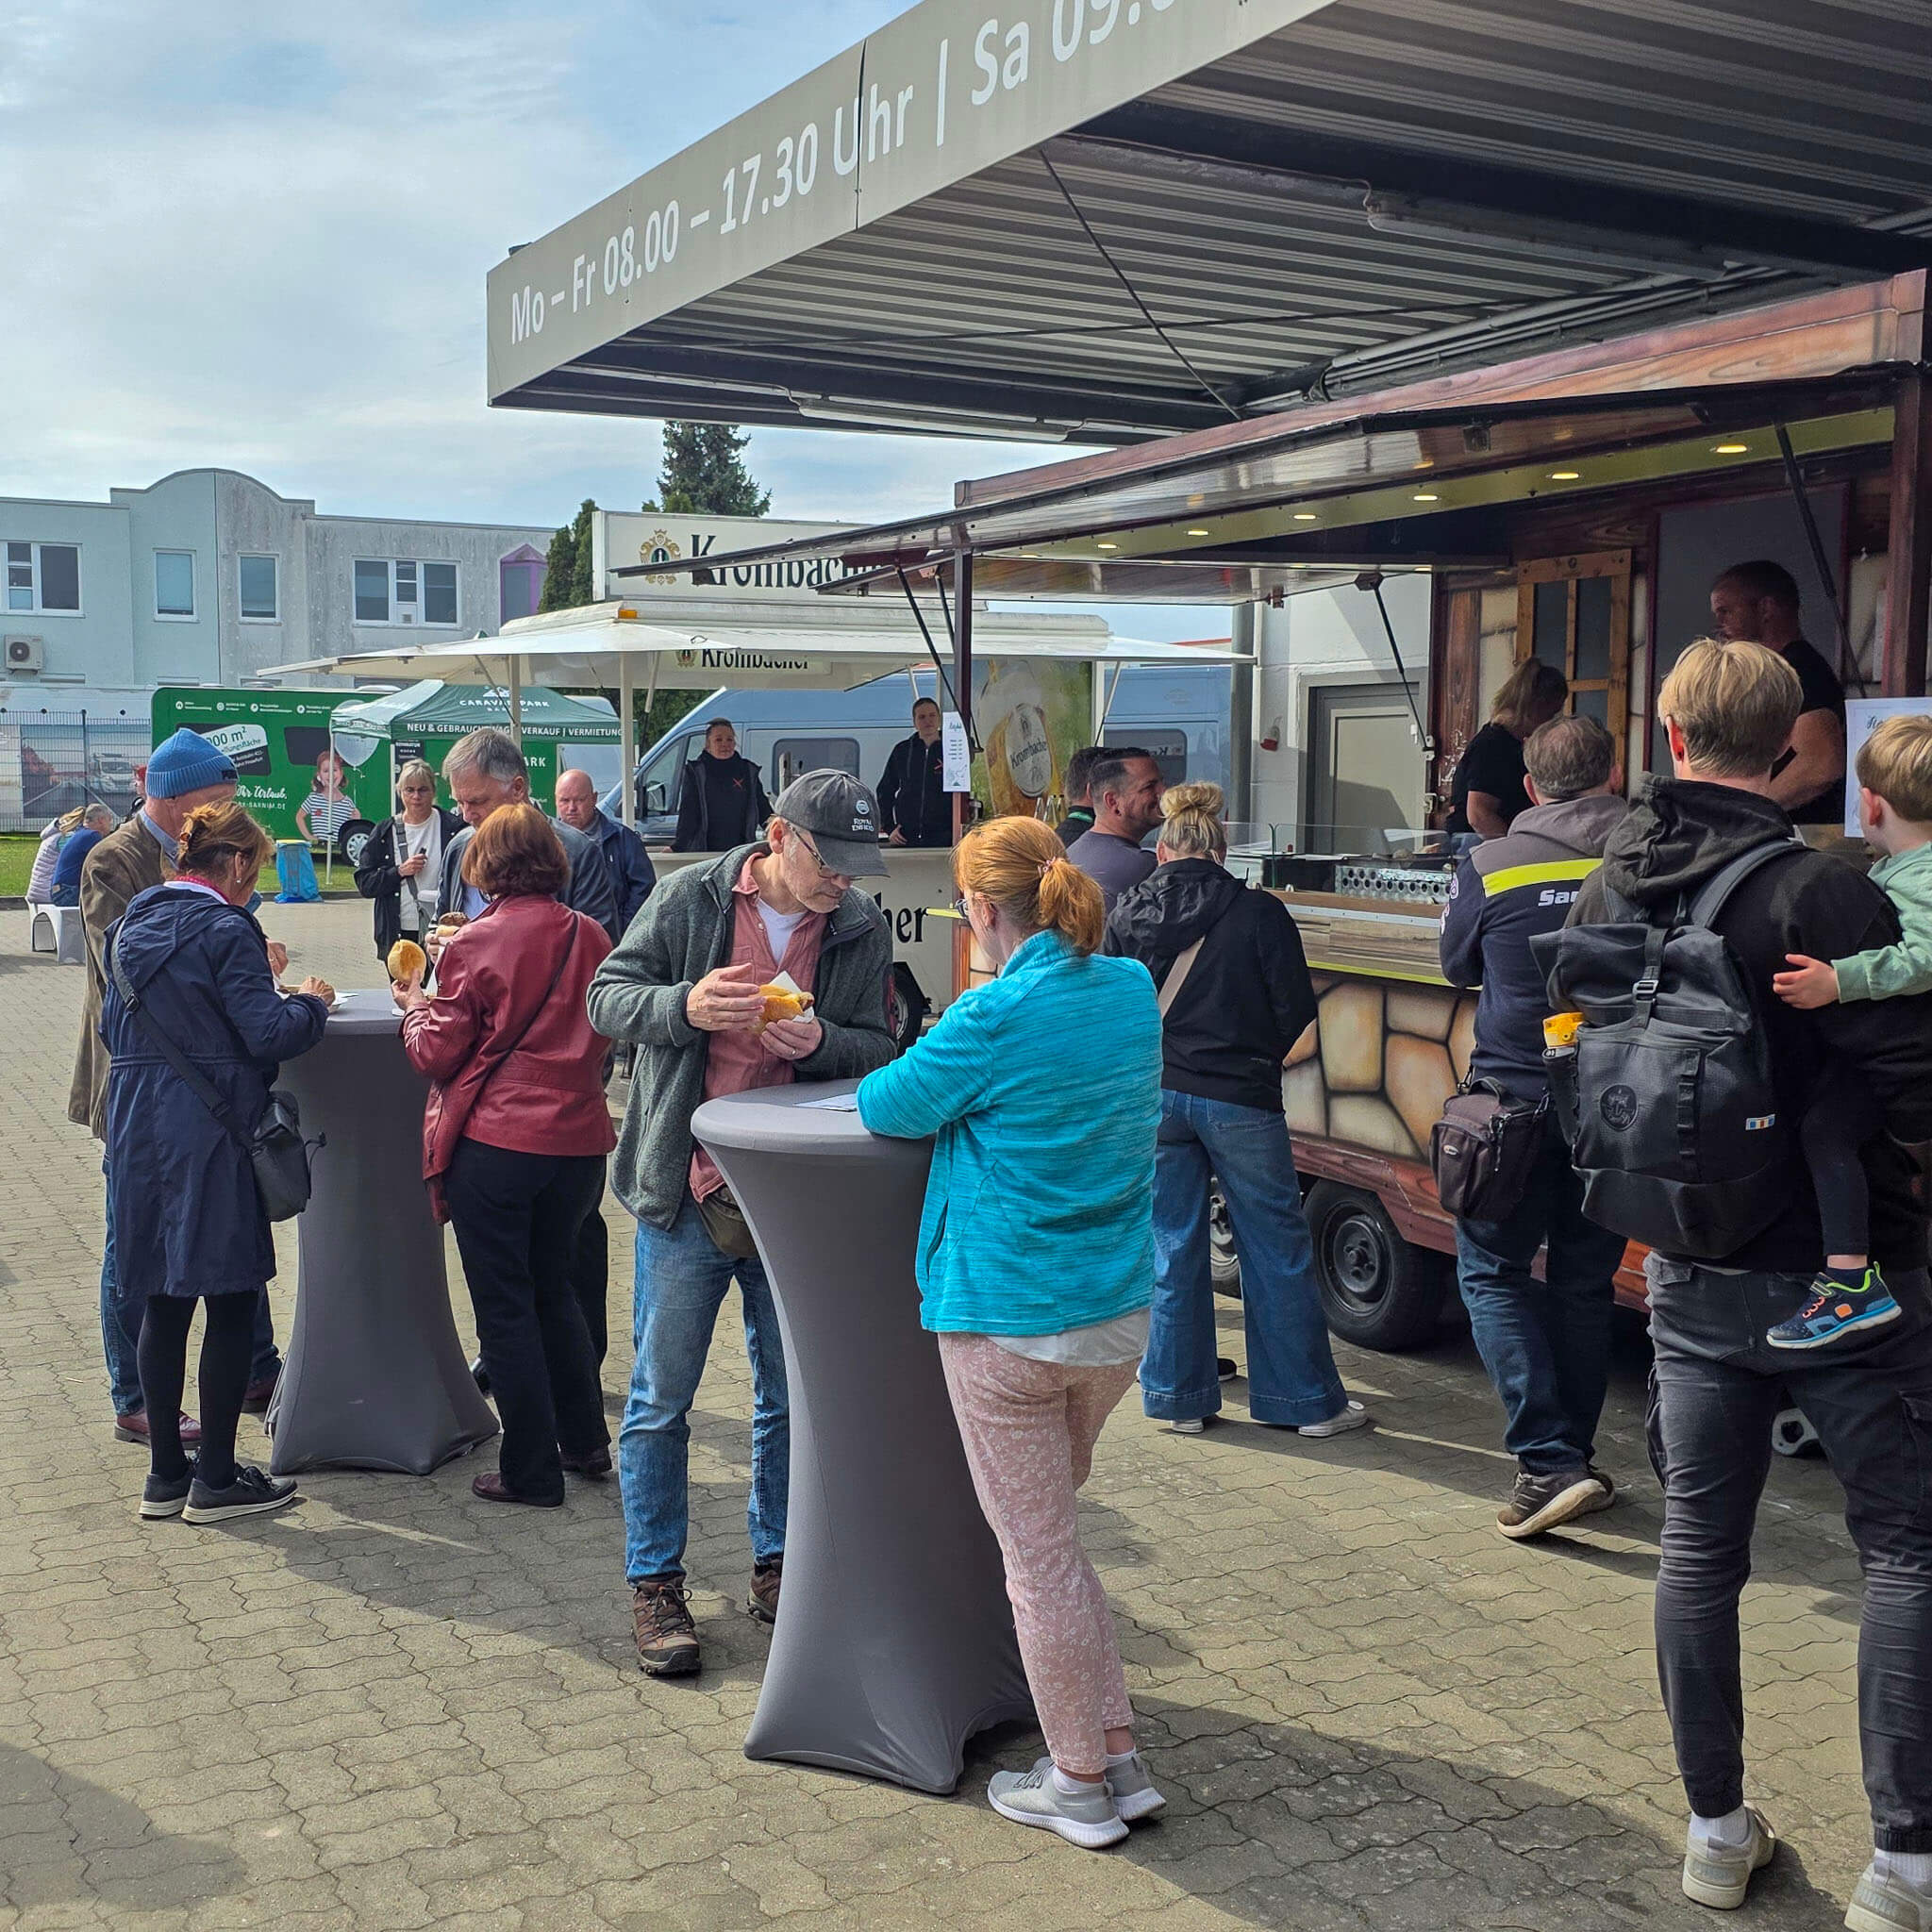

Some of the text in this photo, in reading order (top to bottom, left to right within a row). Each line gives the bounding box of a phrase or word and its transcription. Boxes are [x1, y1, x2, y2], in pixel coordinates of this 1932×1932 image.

[512, 285, 544, 345] Mo
[573, 253, 596, 313] Fr
[603, 200, 679, 296] 08.00
[719, 122, 819, 235] 17.30
[833, 83, 914, 176] Uhr
[971, 18, 1030, 106] Sa
[1052, 0, 1176, 62] 09.
[407, 724, 425, 732] NEU
[428, 724, 435, 732] &
[522, 726, 560, 736] VERKAUF
